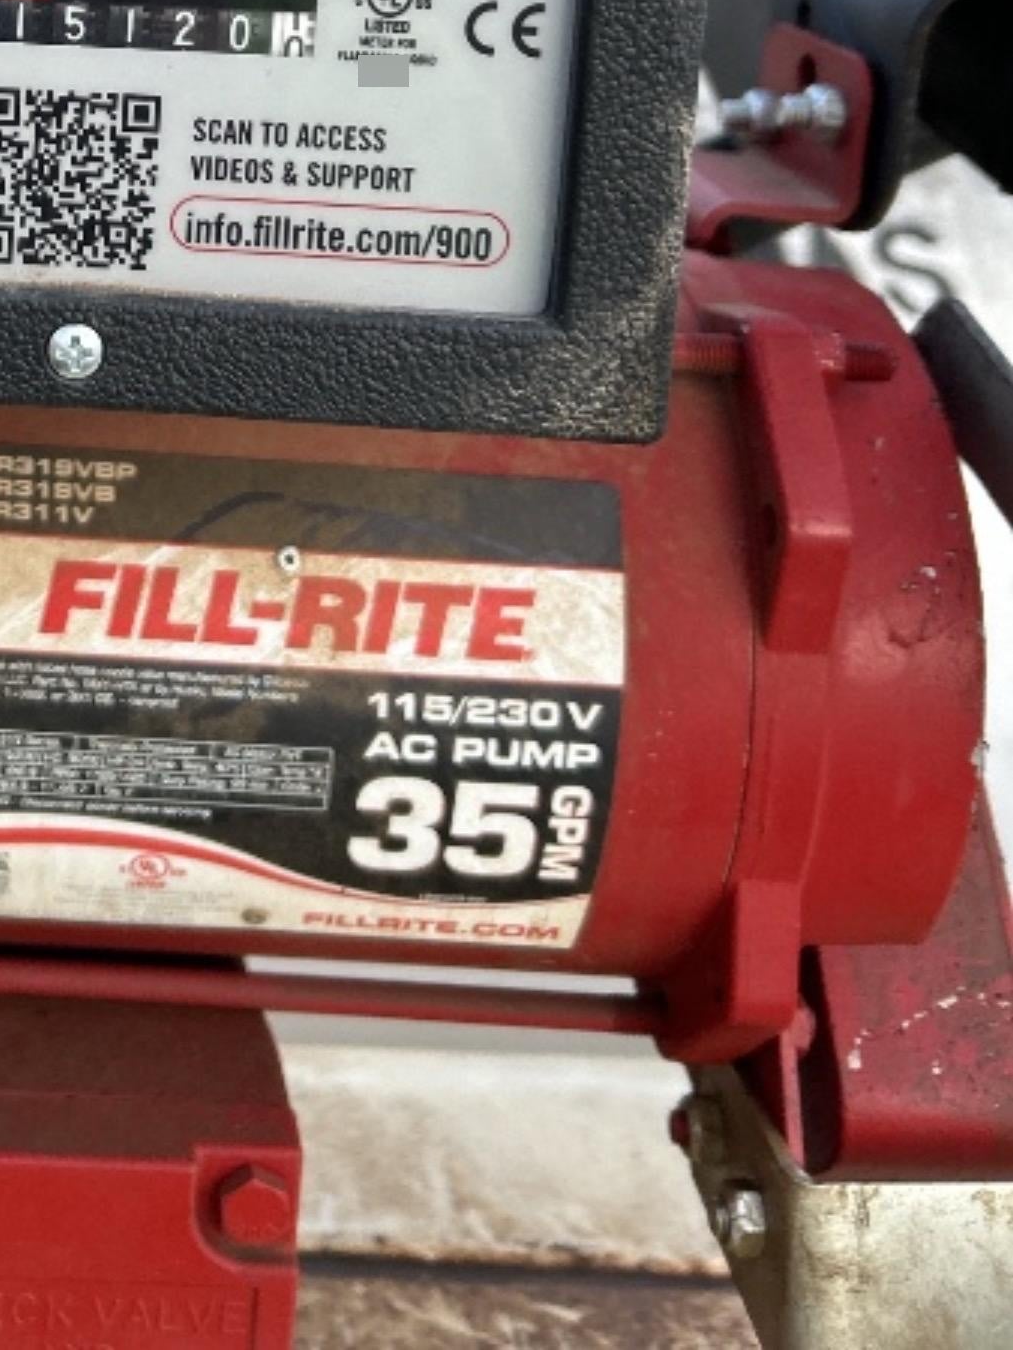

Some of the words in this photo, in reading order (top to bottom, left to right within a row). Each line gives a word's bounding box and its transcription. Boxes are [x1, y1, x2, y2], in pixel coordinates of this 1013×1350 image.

[193, 117, 253, 146] SCAN
[261, 122, 288, 147] TO
[296, 124, 387, 152] ACCESS
[191, 156, 274, 186] VIDEOS
[283, 160, 298, 186] &
[307, 162, 416, 193] SUPPORT
[186, 212, 493, 262] info.fillrite.com/900
[40, 560, 536, 662] FILL-RITE
[368, 692, 563, 729] 115/230
[566, 703, 602, 730] V
[364, 732, 438, 764] AC
[452, 736, 601, 769] PUMP
[346, 776, 540, 877] 35
[538, 785, 594, 881] GPM
[303, 911, 562, 940] FILLRITE.COM
